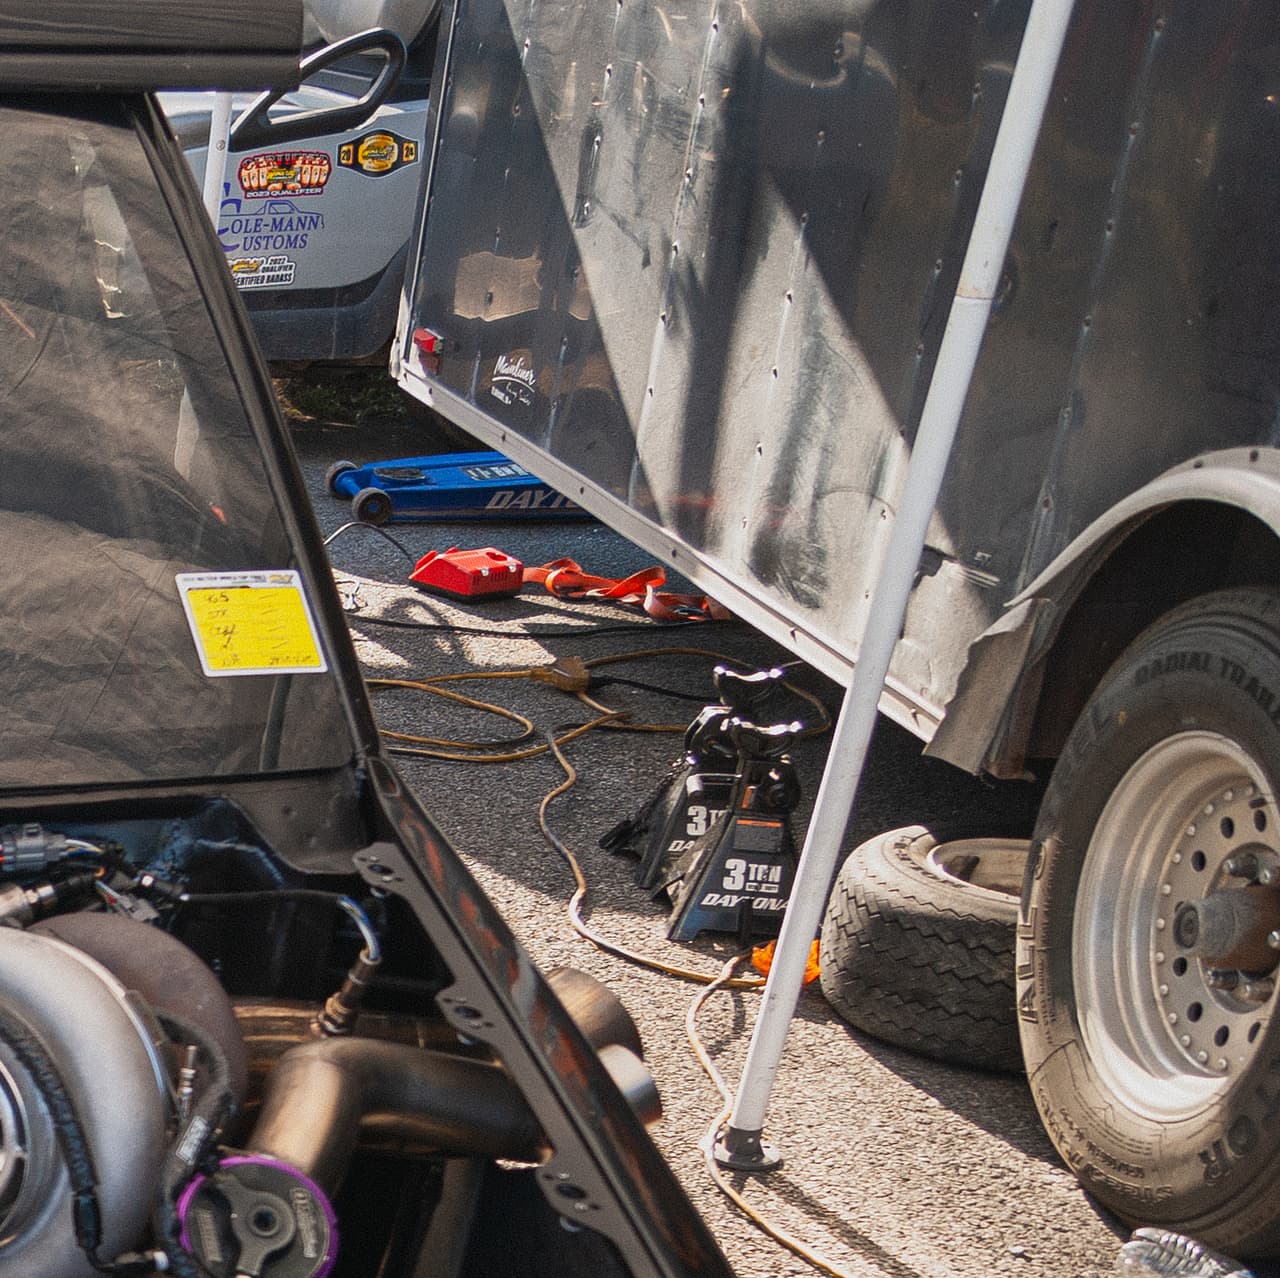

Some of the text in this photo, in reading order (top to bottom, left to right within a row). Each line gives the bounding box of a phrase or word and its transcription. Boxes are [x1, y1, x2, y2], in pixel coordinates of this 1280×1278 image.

[723, 858, 747, 890] 3
[748, 864, 782, 883] TON
[701, 893, 790, 910] DAYONA
